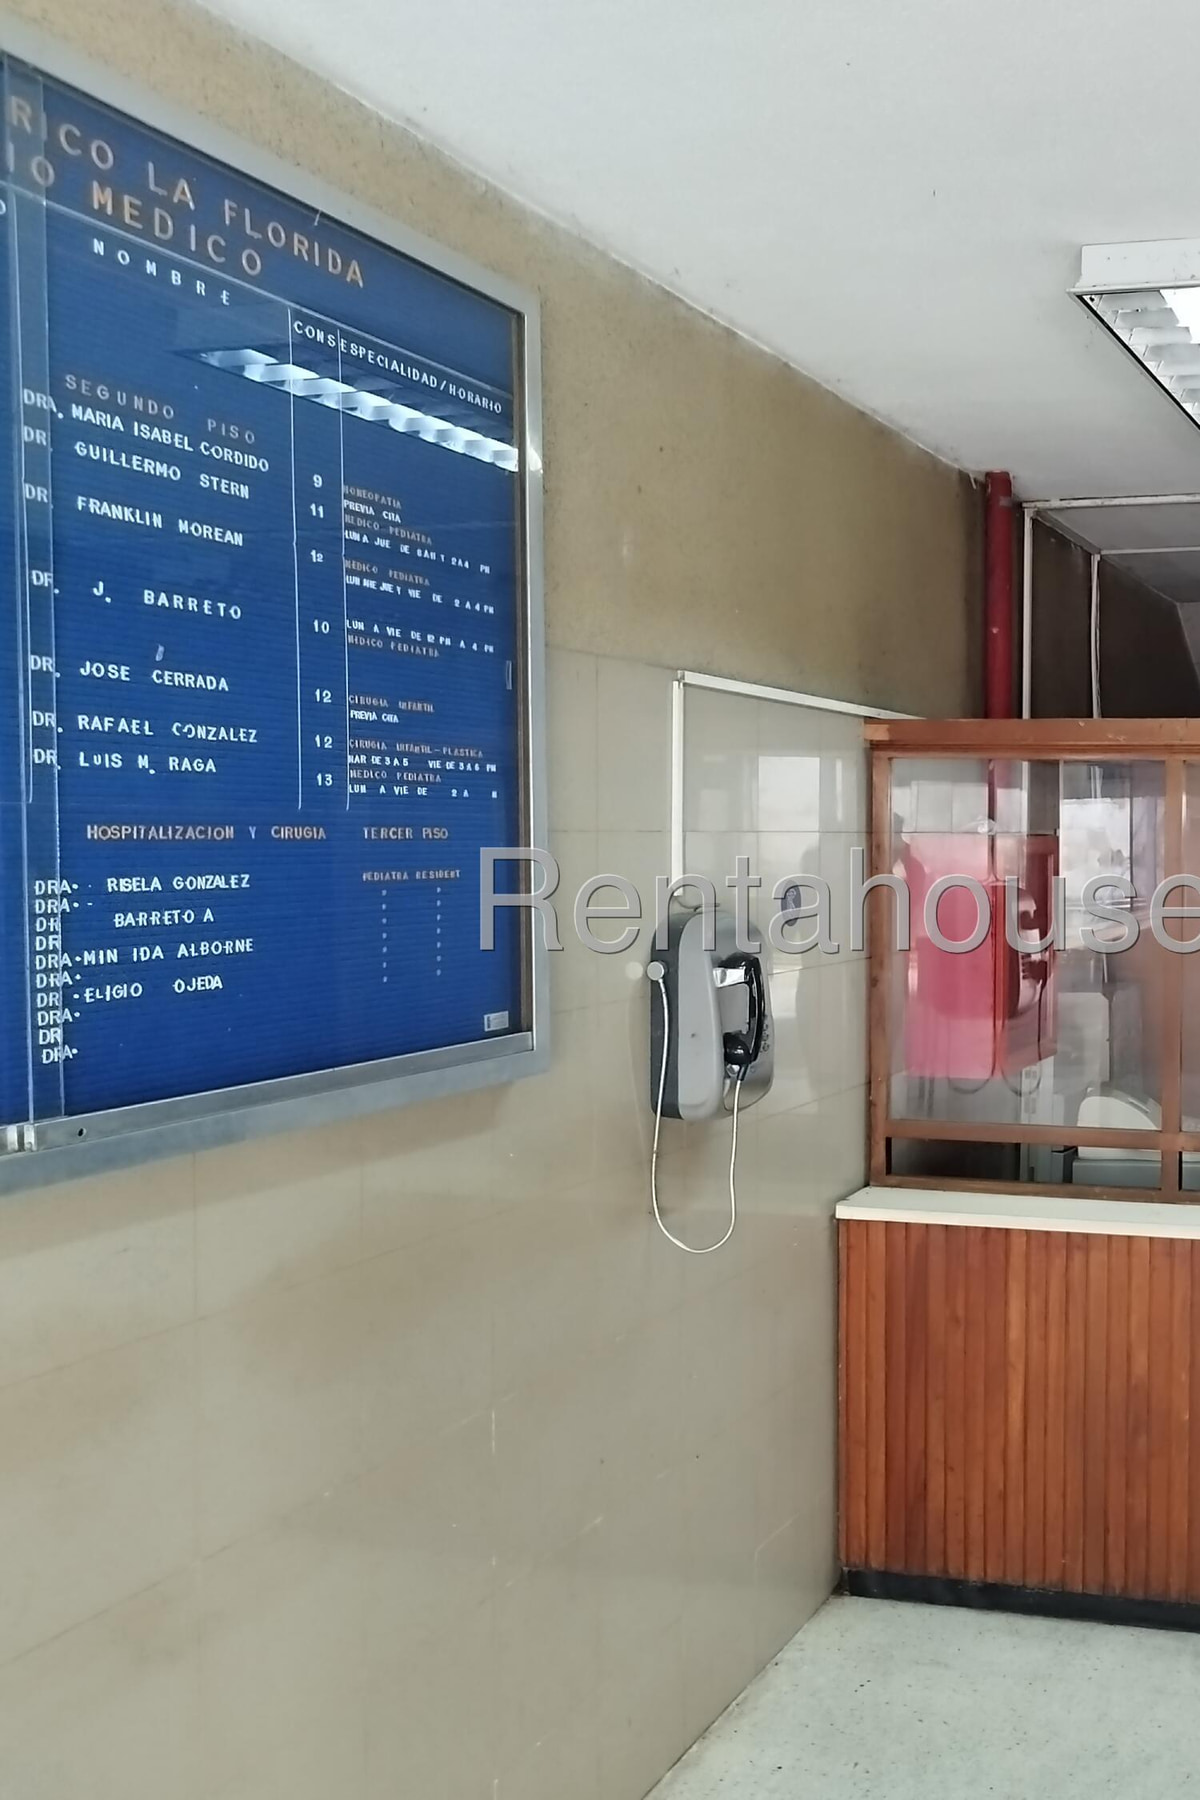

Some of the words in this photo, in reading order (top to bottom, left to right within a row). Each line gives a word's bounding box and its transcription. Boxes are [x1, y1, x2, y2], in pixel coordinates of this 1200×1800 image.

[92, 179, 263, 277] MEDICO
[147, 160, 196, 211] LA
[224, 199, 365, 288] FLORIDA
[93, 237, 231, 306] NOMBRE
[293, 320, 336, 348] CONS
[65, 374, 175, 420] SEGUNDO
[207, 417, 256, 445] PISO
[72, 403, 124, 432] MARIA
[133, 421, 194, 452] ISABEL
[199, 441, 269, 472] CORDIDO
[74, 440, 182, 481] GUILLERMO
[199, 473, 250, 500] STERN
[312, 474, 323, 488] 9
[76, 495, 163, 529] FRANKLIN
[178, 518, 244, 547] MOREAN
[309, 503, 324, 518] 11
[343, 499, 375, 515] PREVIA
[382, 510, 401, 523] CITA
[309, 549, 324, 563] 12
[374, 537, 391, 549] JUE
[399, 543, 411, 555] DE
[92, 581, 111, 603] J.
[143, 589, 242, 619] BARRETO
[432, 592, 443, 603] DE
[313, 619, 330, 634] 10
[373, 623, 380, 634] A
[386, 626, 402, 638] VIE
[410, 630, 422, 642] DE
[460, 639, 466, 649] A
[80, 660, 132, 682] JOSE
[151, 669, 230, 692] CERRADA
[315, 688, 332, 703] 12
[349, 694, 389, 708] CIRUGIA
[77, 714, 155, 736] RAFAEL
[350, 709, 378, 721] PREVIA
[381, 712, 399, 723] CITA
[314, 734, 333, 749] 12
[349, 739, 388, 751] CIRUGIA
[78, 751, 123, 769] LUIS
[138, 753, 156, 775] M.
[168, 756, 217, 773] RAGA
[371, 755, 382, 765] DE
[428, 760, 441, 769] VIE
[317, 772, 333, 787] 13
[379, 784, 386, 794] A
[393, 785, 409, 796] VIE
[417, 786, 428, 796] DE
[86, 824, 235, 841] HOSPITALIZACION
[249, 825, 257, 840] Y
[270, 825, 327, 840] CIRUGIA
[362, 827, 414, 840] TERCER
[422, 827, 449, 840] PISO
[107, 876, 163, 893] RISELA
[172, 874, 250, 891] GONZALEZ
[113, 908, 195, 928] BARRETO
[203, 907, 214, 923] A
[83, 948, 118, 966] MIN
[133, 945, 164, 963] IDA
[177, 938, 254, 959] ALBORNE
[84, 982, 143, 1003] ELIGIO
[173, 974, 223, 994] OJEDA
